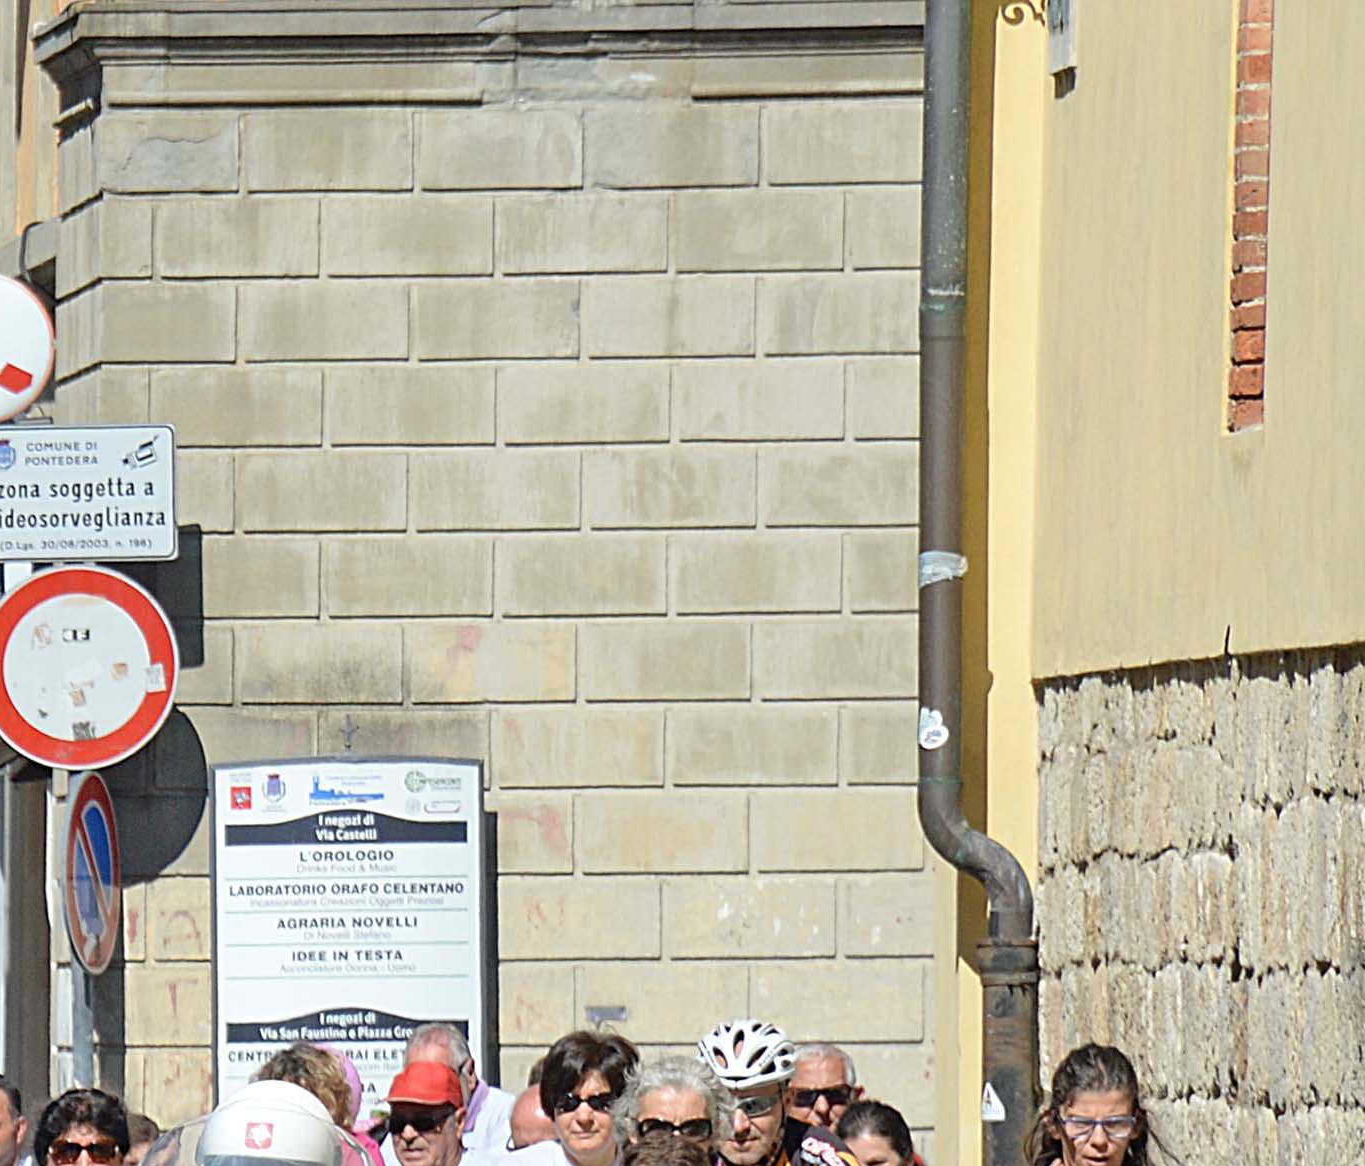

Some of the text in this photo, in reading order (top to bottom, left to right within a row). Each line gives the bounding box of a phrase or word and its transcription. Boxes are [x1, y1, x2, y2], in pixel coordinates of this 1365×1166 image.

[25, 442, 98, 452] COMUNE DI
[25, 456, 99, 466] PONTEDERA
[49, 478, 135, 503] soggetta
[144, 480, 155, 496] a
[325, 815, 361, 829] negozi
[363, 814, 374, 826] di
[315, 829, 377, 842] Via Castelli
[299, 850, 395, 862] L'OROLOGIO
[331, 863, 355, 872] Food
[229, 882, 464, 896] LABORATORIO ORAFO CELENTANO
[277, 916, 418, 929] AGRARIA NOVELLI
[292, 950, 403, 962] IDEE IN TESTA
[326, 1013, 362, 1027] negozi
[365, 1012, 376, 1024] di
[260, 1028, 278, 1040] Via
[280, 1028, 299, 1040] San
[301, 1027, 347, 1039] Faustino
[349, 1030, 356, 1039] e
[358, 1026, 393, 1039] Piazza
